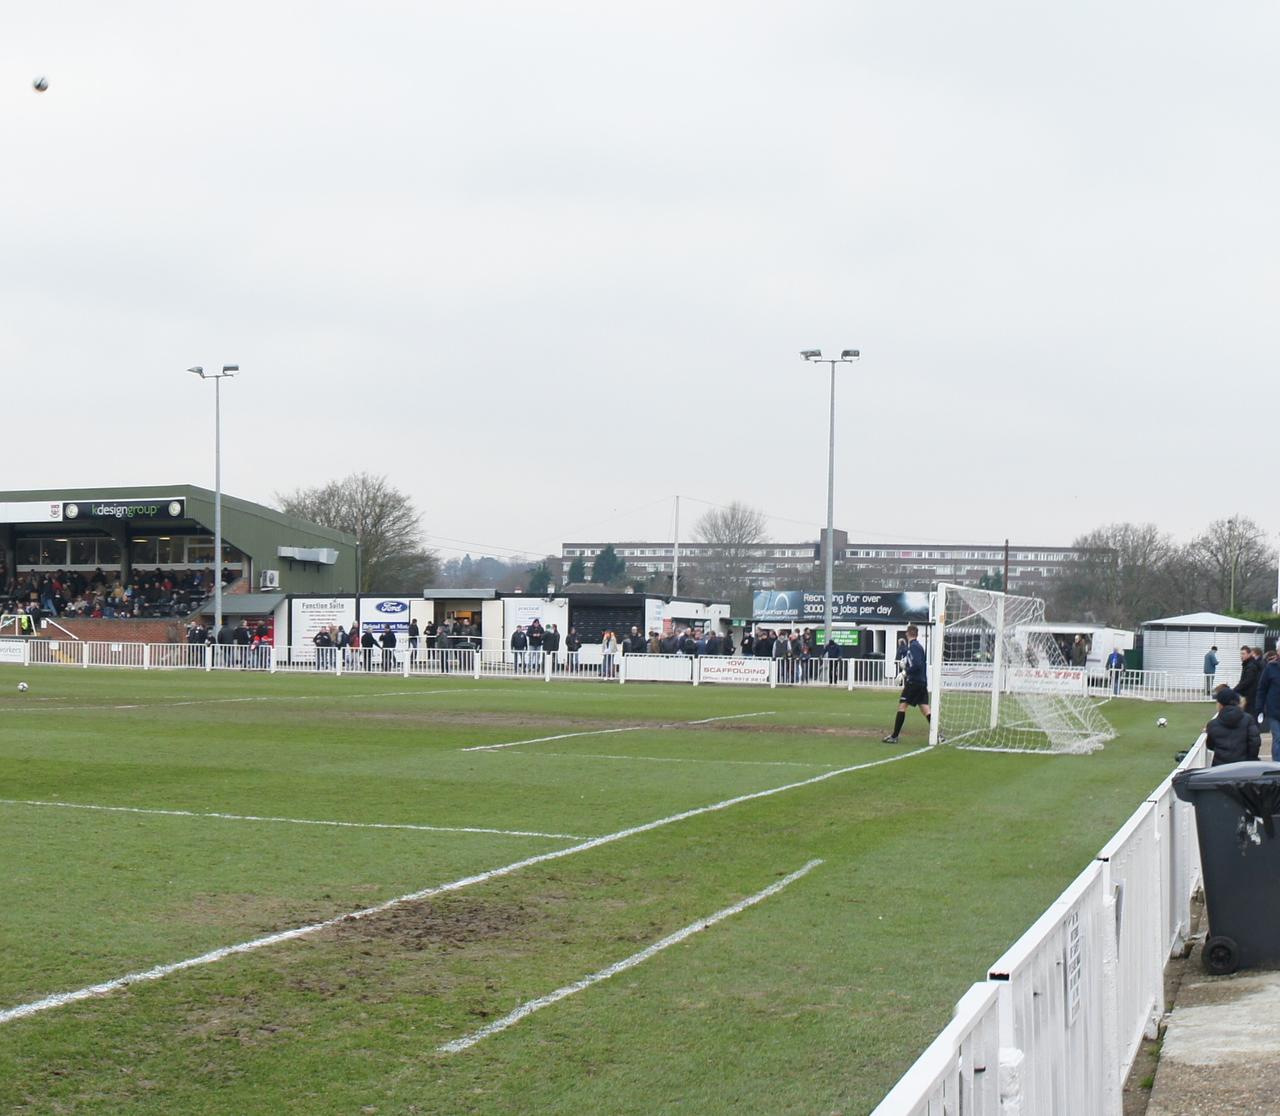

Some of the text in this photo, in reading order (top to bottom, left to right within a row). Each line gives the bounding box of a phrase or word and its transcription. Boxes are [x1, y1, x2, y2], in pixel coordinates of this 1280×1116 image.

[91, 504, 158, 517] kdesigngroup
[804, 593, 844, 604] Recruing
[846, 593, 861, 602] for
[302, 602, 345, 610] Function Suite
[381, 601, 402, 612] Ford
[804, 605, 825, 614] 3000
[840, 605, 858, 615] jobs
[859, 606, 877, 615] per
[877, 606, 893, 616] day
[703, 667, 766, 675] SCAFFOLDING
